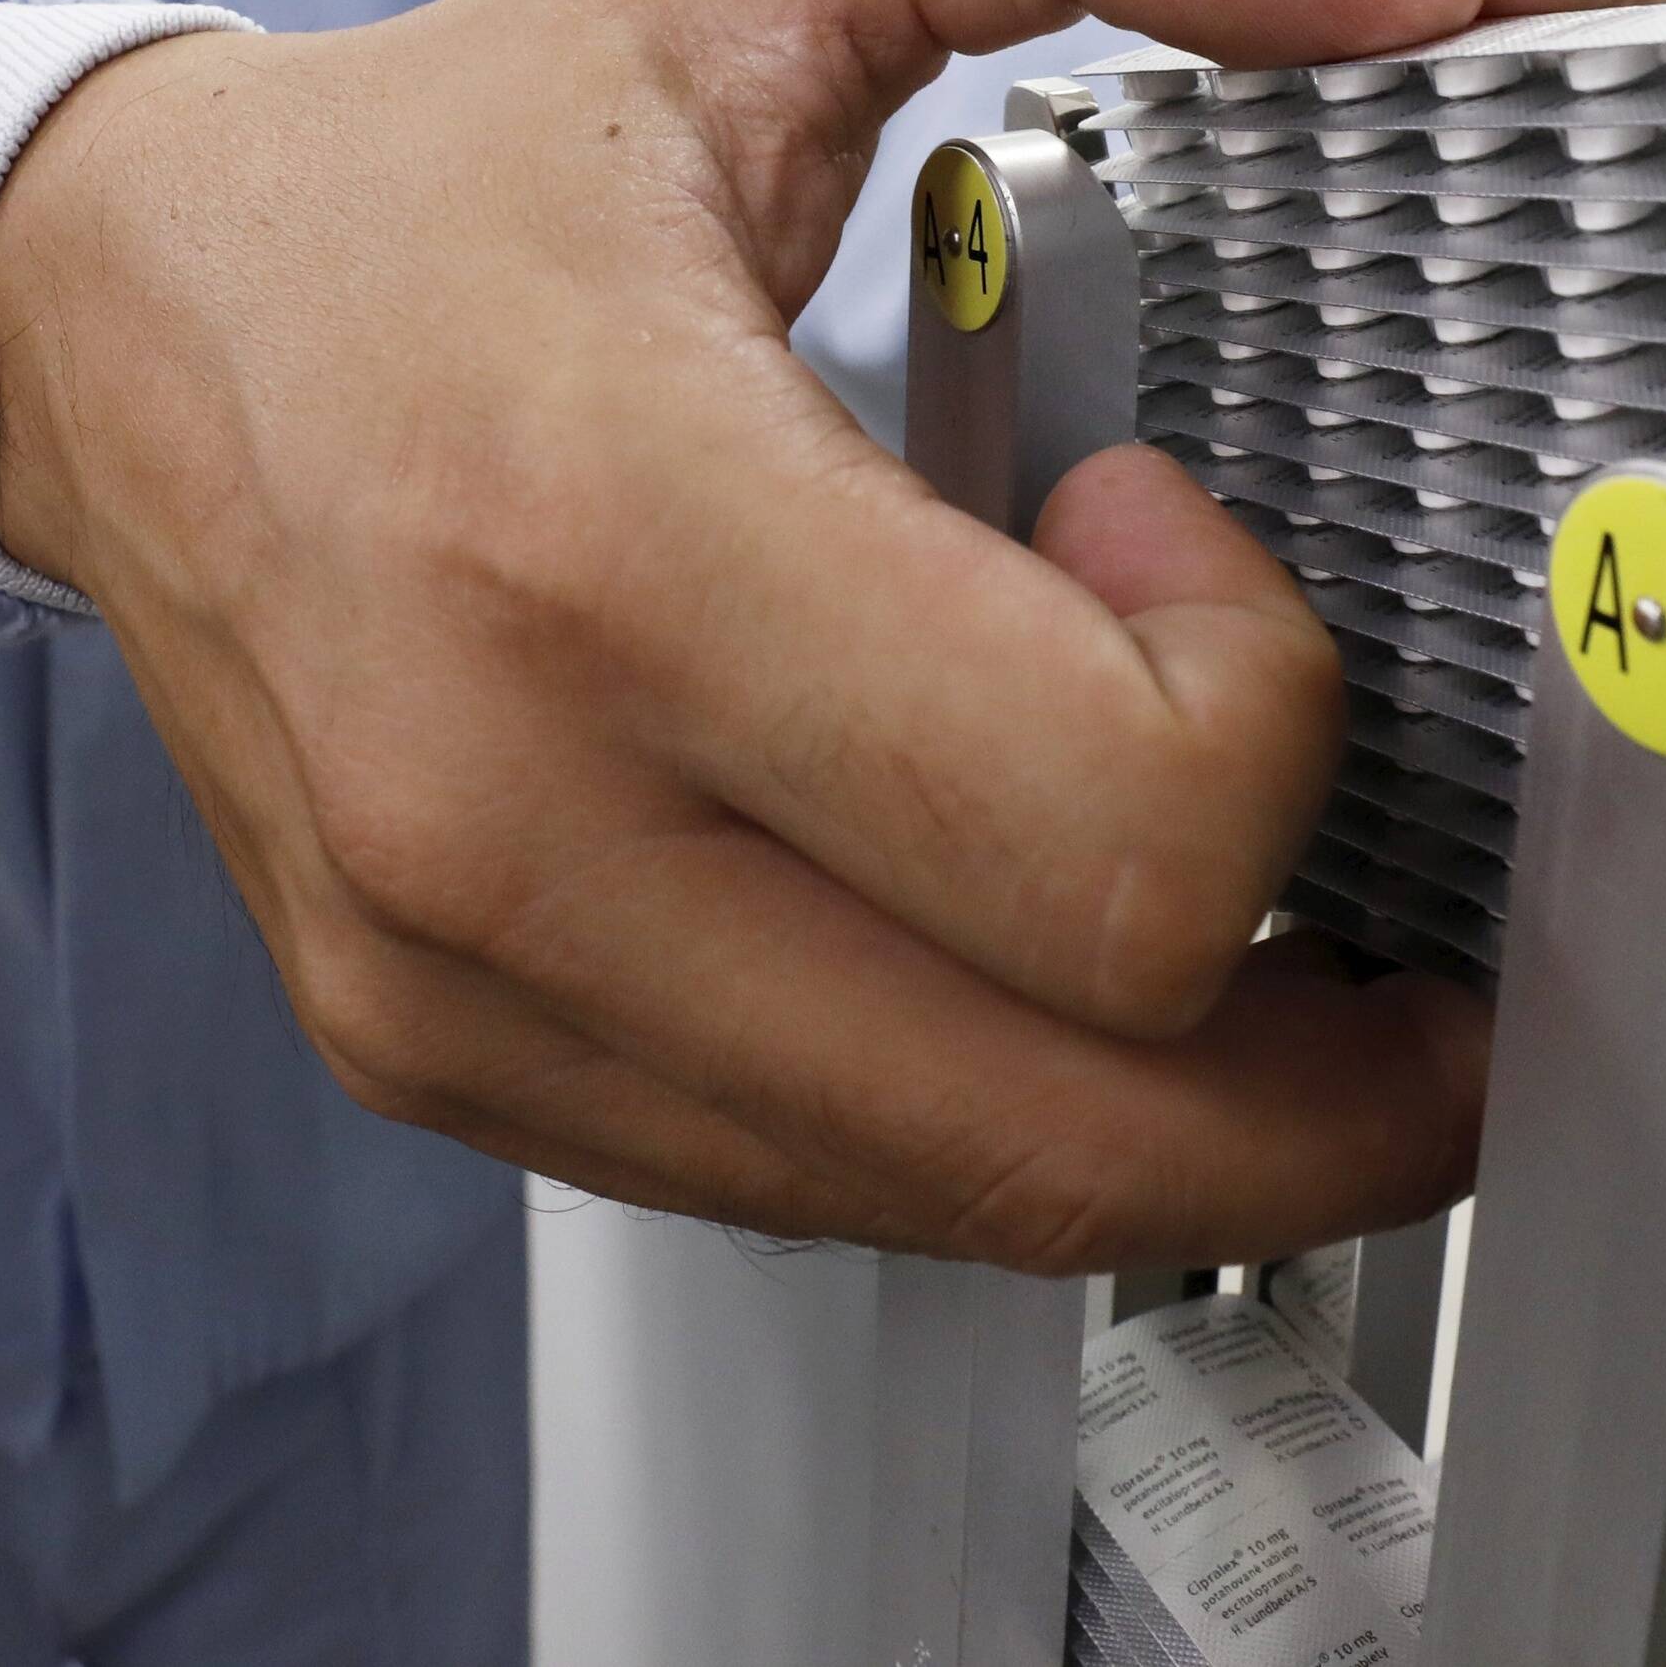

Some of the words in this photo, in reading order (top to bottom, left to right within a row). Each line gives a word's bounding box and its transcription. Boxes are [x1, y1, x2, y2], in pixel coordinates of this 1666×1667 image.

[1247, 1539, 1266, 1556] 10
[1267, 1528, 1290, 1545] mg
[1261, 1542, 1300, 1568] tablety
[1244, 1587, 1297, 1628] Lundbeck
[1295, 1574, 1318, 1596] A/S
[1334, 1642, 1353, 1660] 10
[1354, 1629, 1378, 1649] mg
